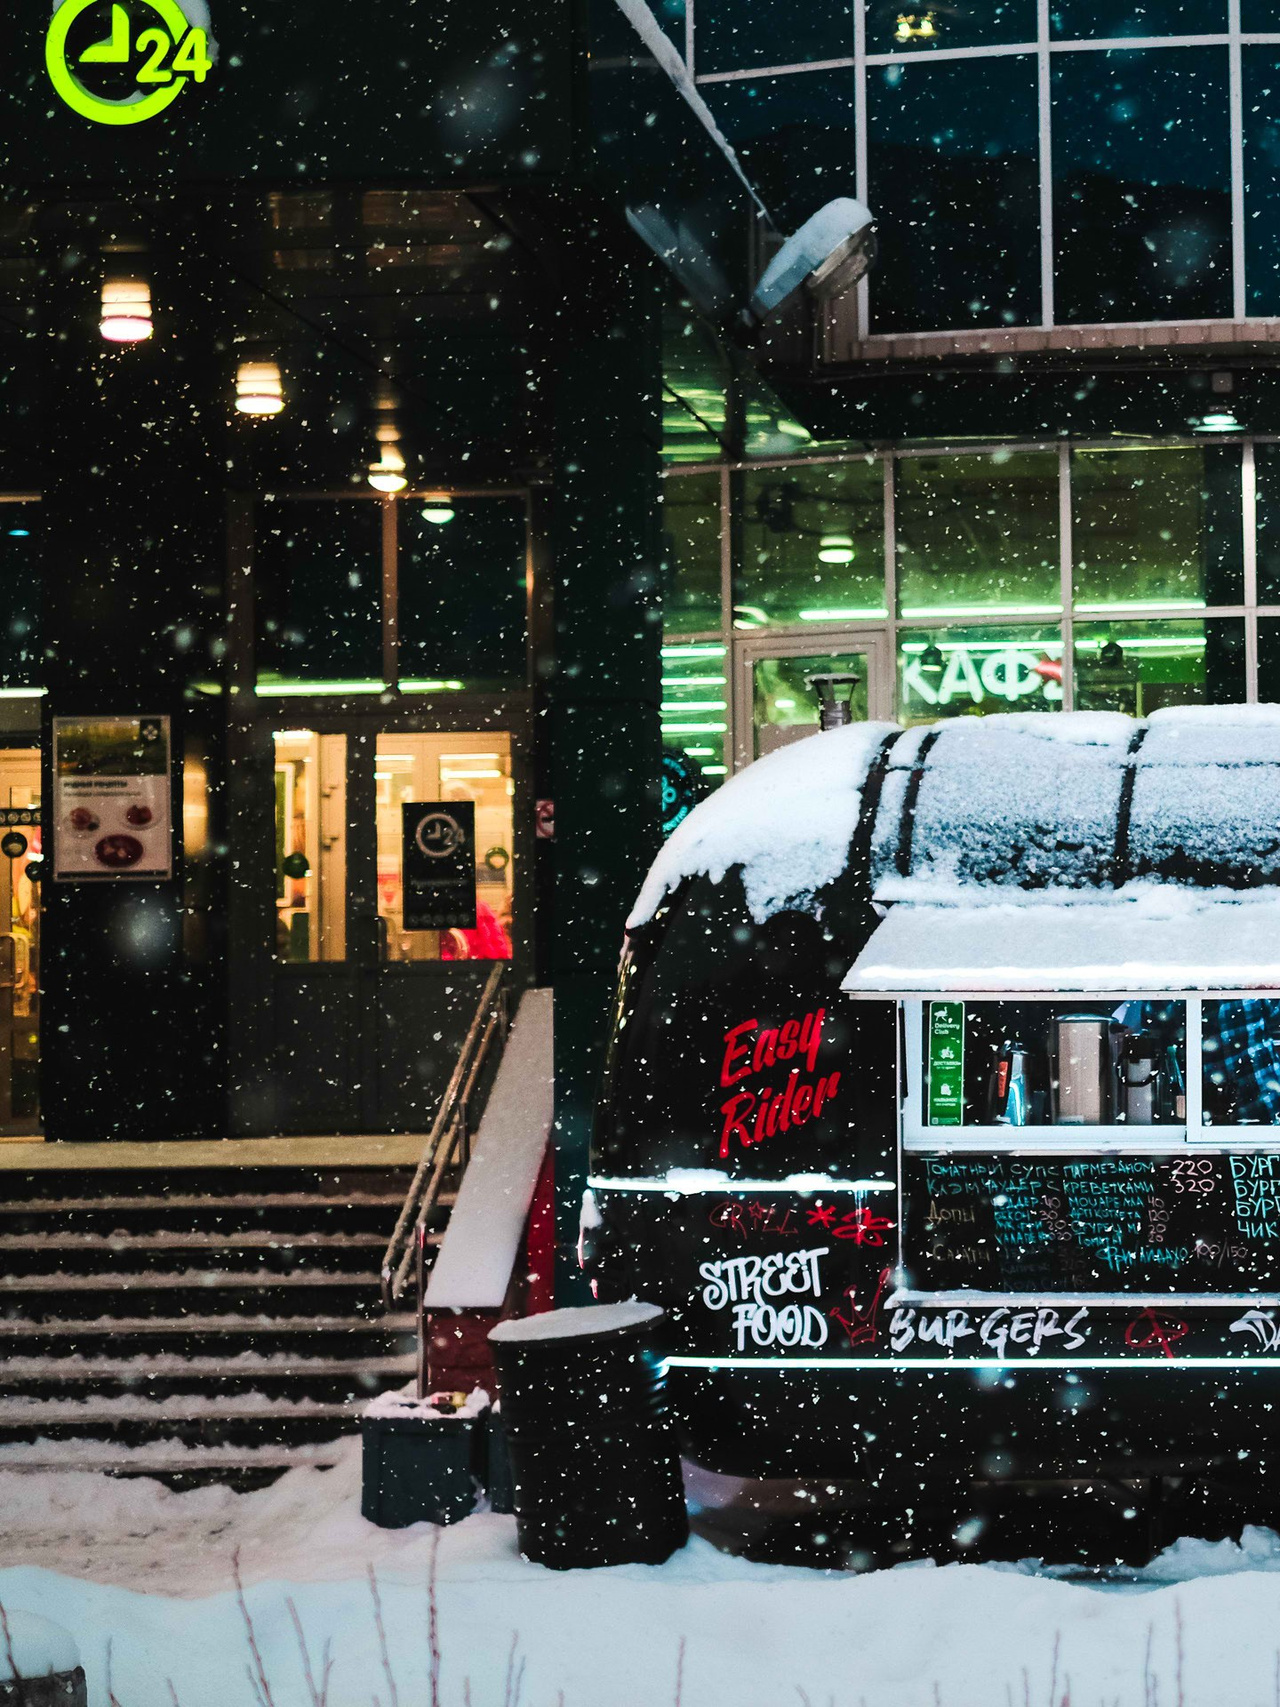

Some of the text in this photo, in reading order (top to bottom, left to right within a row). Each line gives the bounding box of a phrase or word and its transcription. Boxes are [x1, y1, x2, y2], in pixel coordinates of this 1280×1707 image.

[136, 28, 213, 83] 24
[443, 827, 466, 847] 24
[720, 1007, 825, 1088] Easy
[719, 1070, 841, 1159] Rider
[992, 1196, 1039, 1209] ДДЕР
[700, 1247, 829, 1311] STREET
[732, 1304, 828, 1351] FOOD
[889, 1308, 1090, 1358] BURGERS
